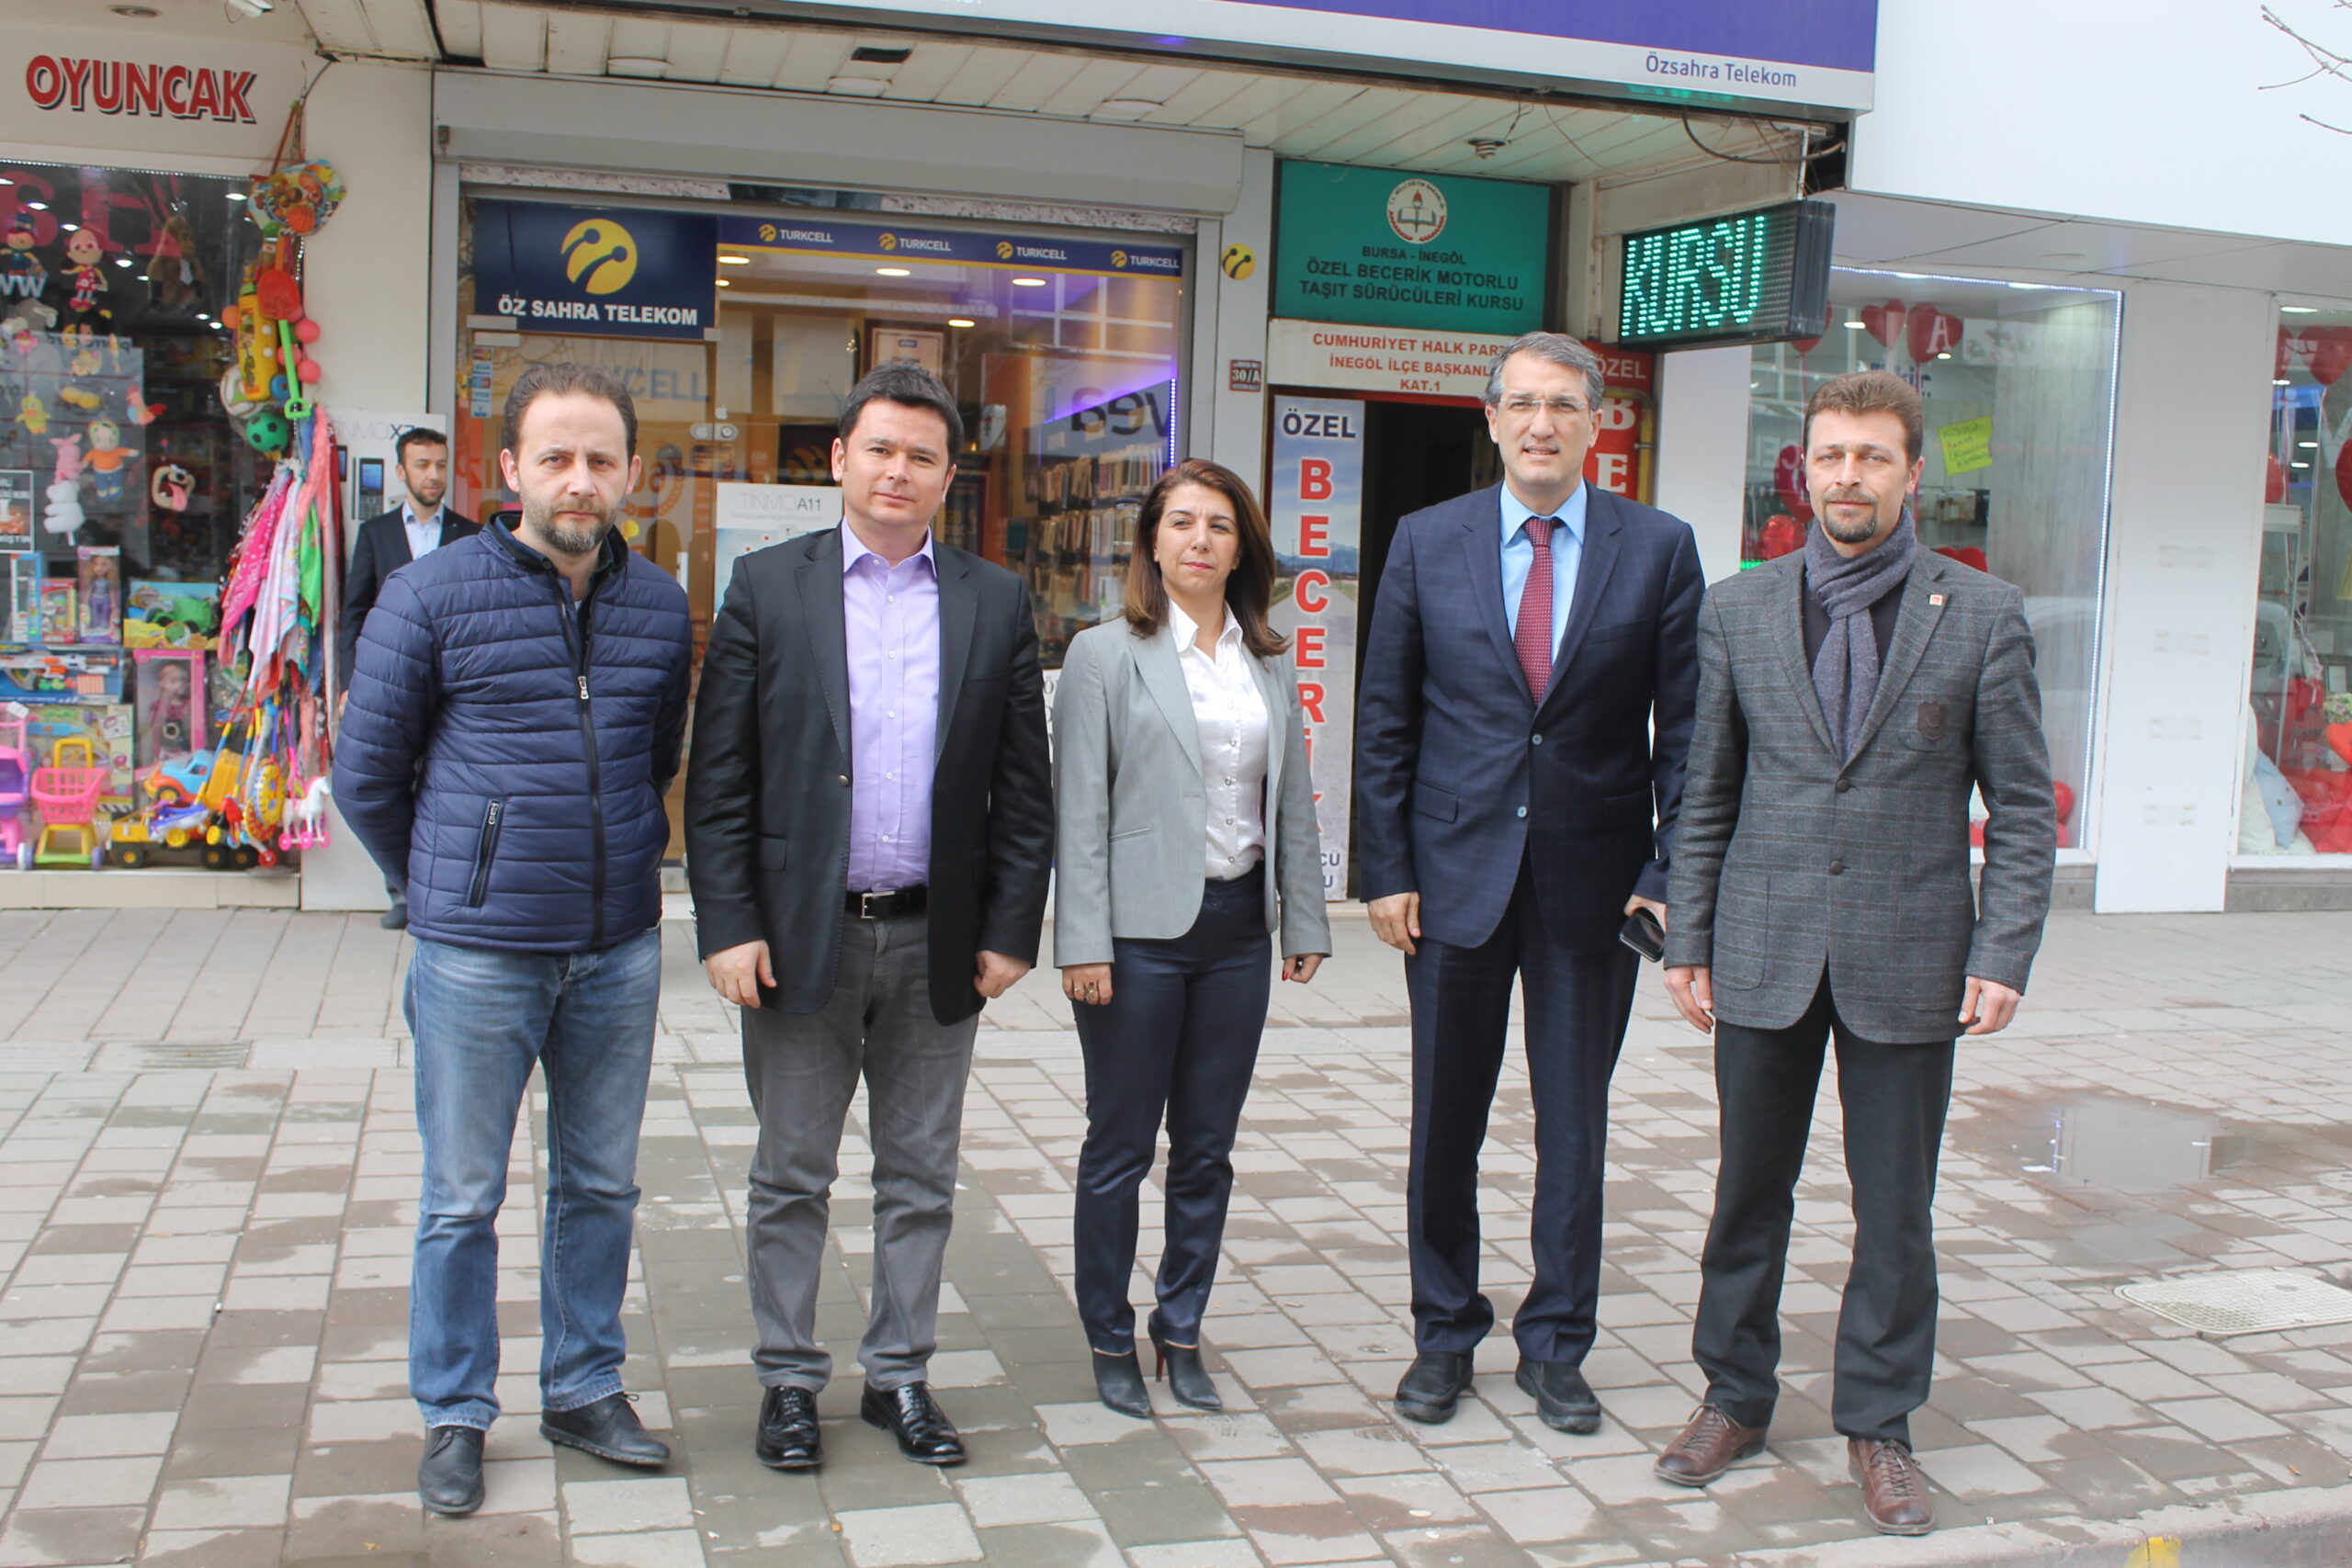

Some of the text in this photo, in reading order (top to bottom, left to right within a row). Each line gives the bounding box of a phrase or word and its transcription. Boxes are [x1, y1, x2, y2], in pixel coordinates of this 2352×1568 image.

[1645, 51, 1797, 87] Özsahra Telekom
[26, 55, 257, 124] OYUNCAK
[780, 229, 833, 243] TURKCELL
[899, 237, 952, 252] TURKCELL
[1016, 245, 1068, 261] TURKCELL
[1130, 254, 1180, 269] TURKCELL
[1362, 245, 1467, 265] BURSA İNEGÖL
[1307, 257, 1519, 290] ÖZEL BECERİK MOTORLU
[1622, 216, 1765, 337] KURSU
[1300, 279, 1523, 311] TAŞIT SÜRÜCÜLERİ KURSU
[498, 294, 698, 326] ÖZ SAHRA TELEKOM
[1312, 333, 1418, 352] CUMHURİYET
[1422, 340, 1464, 355] HALK
[1329, 353, 1383, 371] İNEGÖL
[1388, 357, 1419, 374] İLÇE
[1594, 354, 1647, 379] ÖZEL
[1232, 368, 1261, 383] 30/A
[1399, 378, 1441, 392] KAT.1
[1282, 408, 1357, 439] ÖZEL
